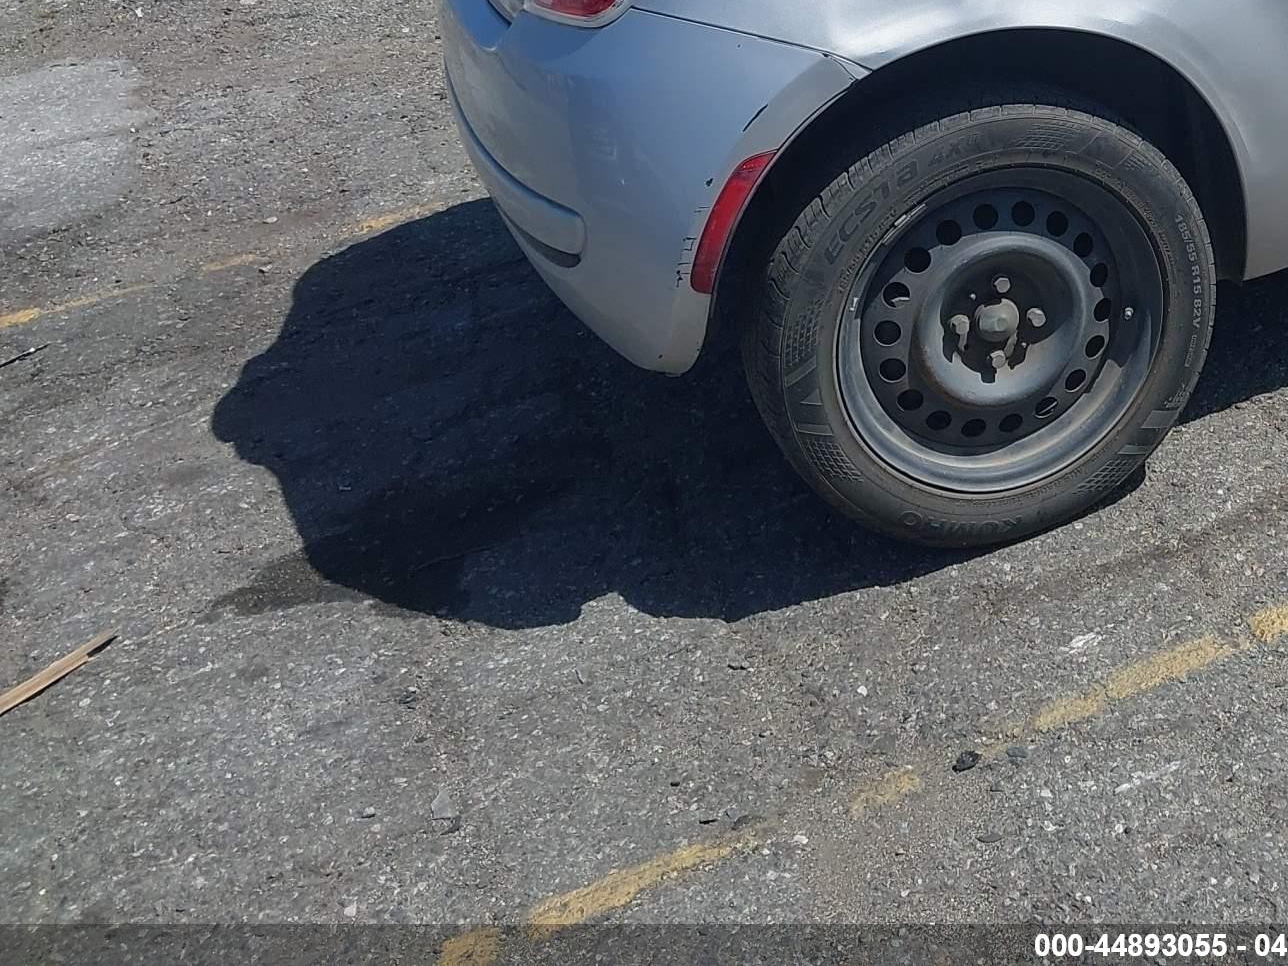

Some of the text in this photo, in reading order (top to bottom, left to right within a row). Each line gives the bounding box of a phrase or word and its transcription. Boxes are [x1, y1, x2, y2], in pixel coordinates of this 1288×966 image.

[1174, 214, 1202, 328] 185/55 R15 82V
